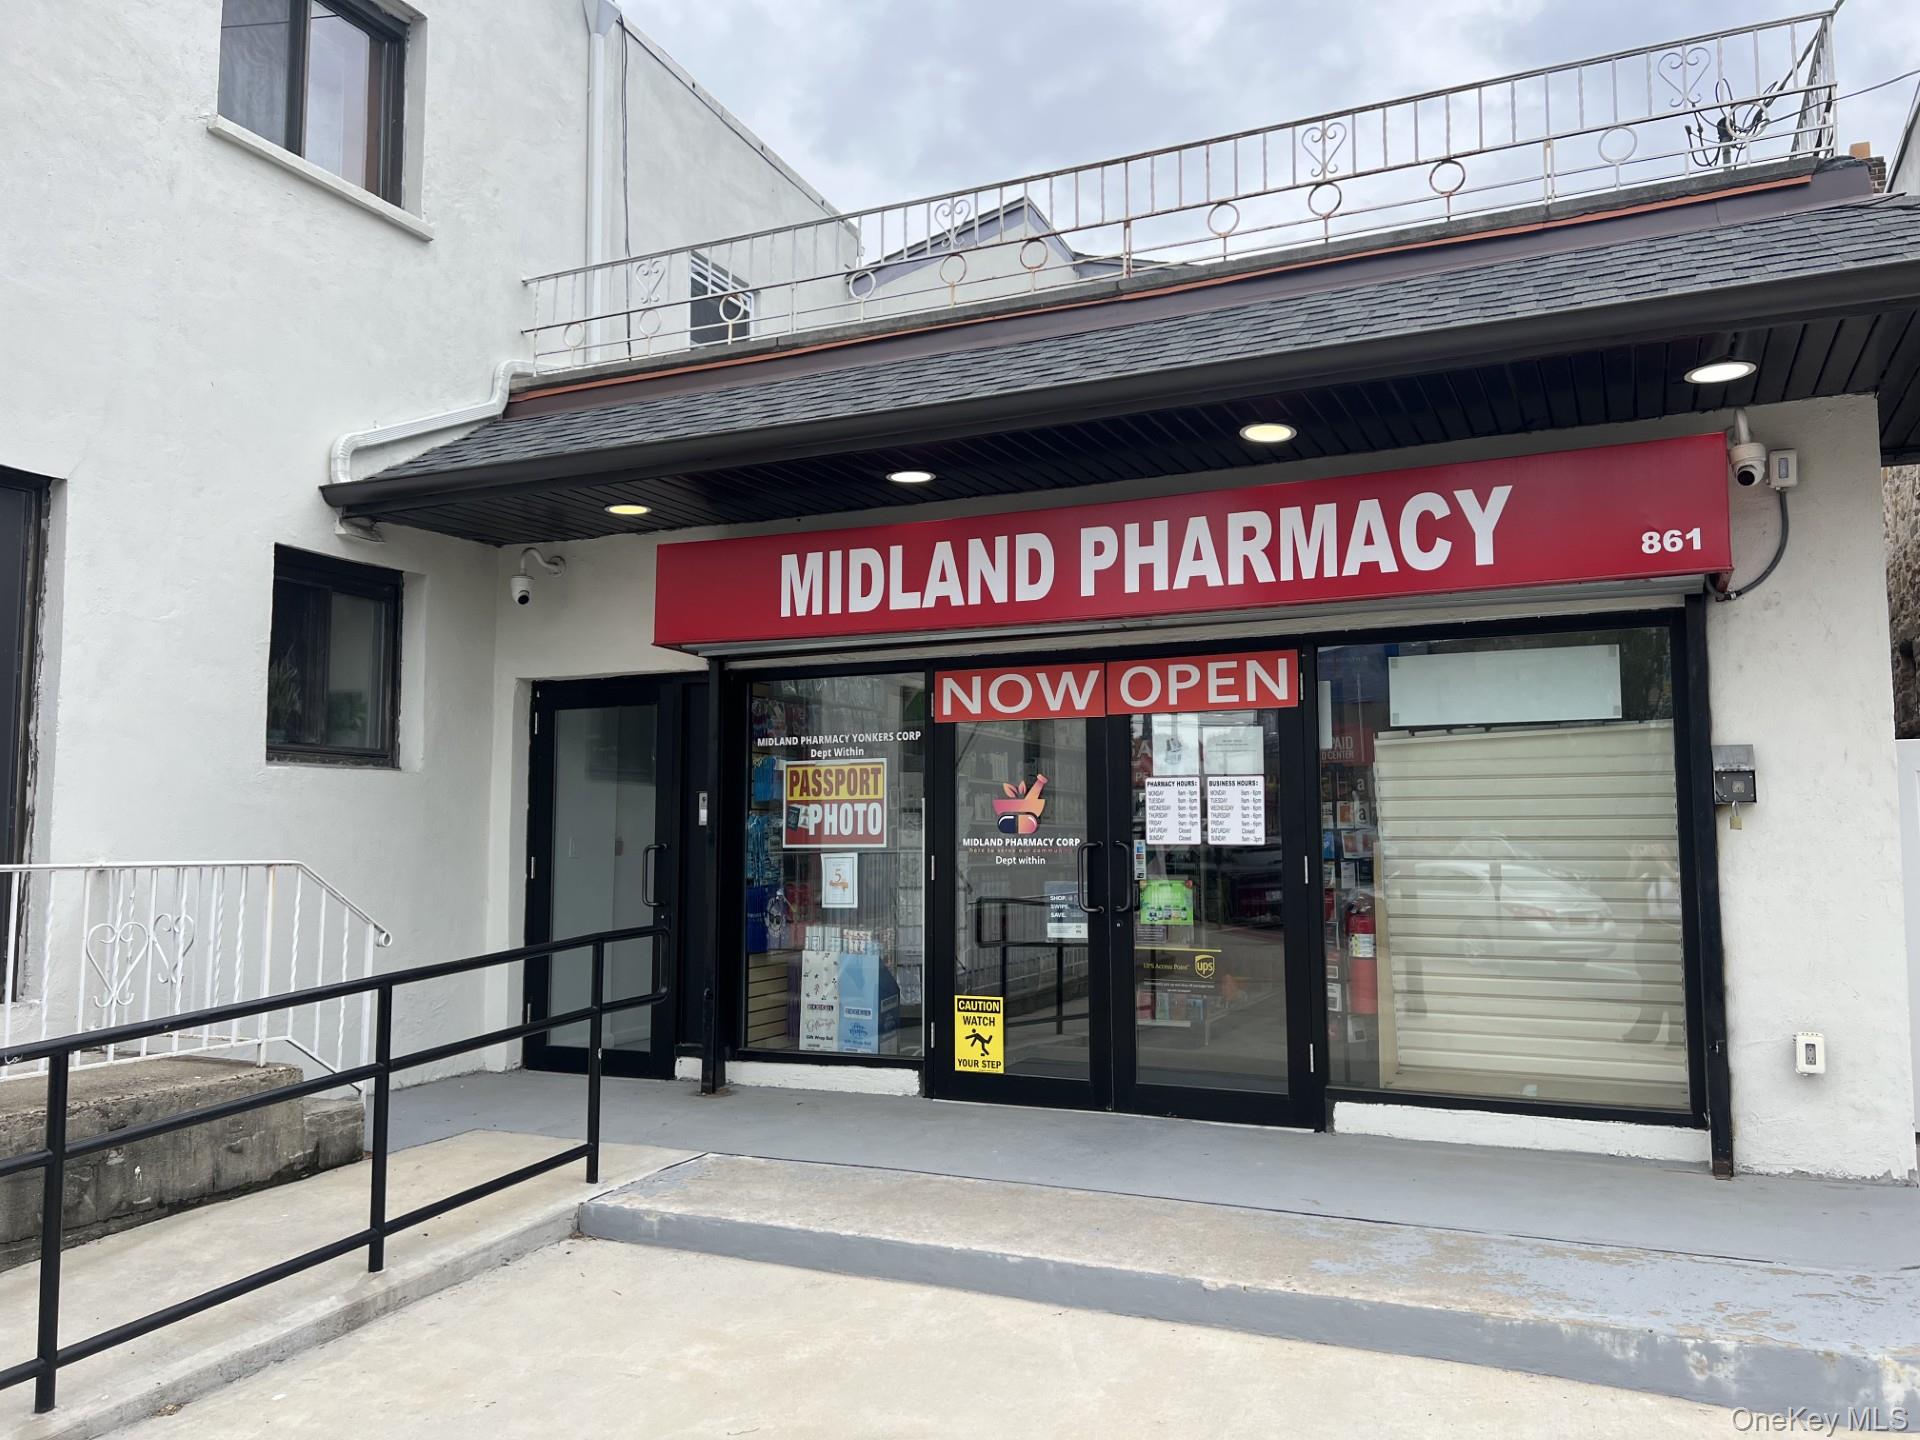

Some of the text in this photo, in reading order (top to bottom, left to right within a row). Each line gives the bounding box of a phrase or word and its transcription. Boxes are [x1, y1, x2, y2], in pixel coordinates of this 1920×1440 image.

[1641, 527, 1703, 555] 861
[780, 485, 1513, 618] MIDLAND PHARMACY
[942, 658, 1290, 717] NOW OPEN
[757, 731, 922, 747] MIDLAND PHARMACY YONKERS CORP
[810, 747, 865, 760] Dept Within
[789, 767, 882, 797] PASSPORT
[808, 802, 882, 836] PHOTO
[962, 838, 1081, 847] MIDLAND PHARMACY CORP
[995, 856, 1046, 866] Dept within
[1197, 962, 1213, 975] ups
[958, 1000, 1000, 1012] CAUTION
[962, 1015, 996, 1028] WATCH
[957, 1058, 1002, 1070] YOUR STEP
